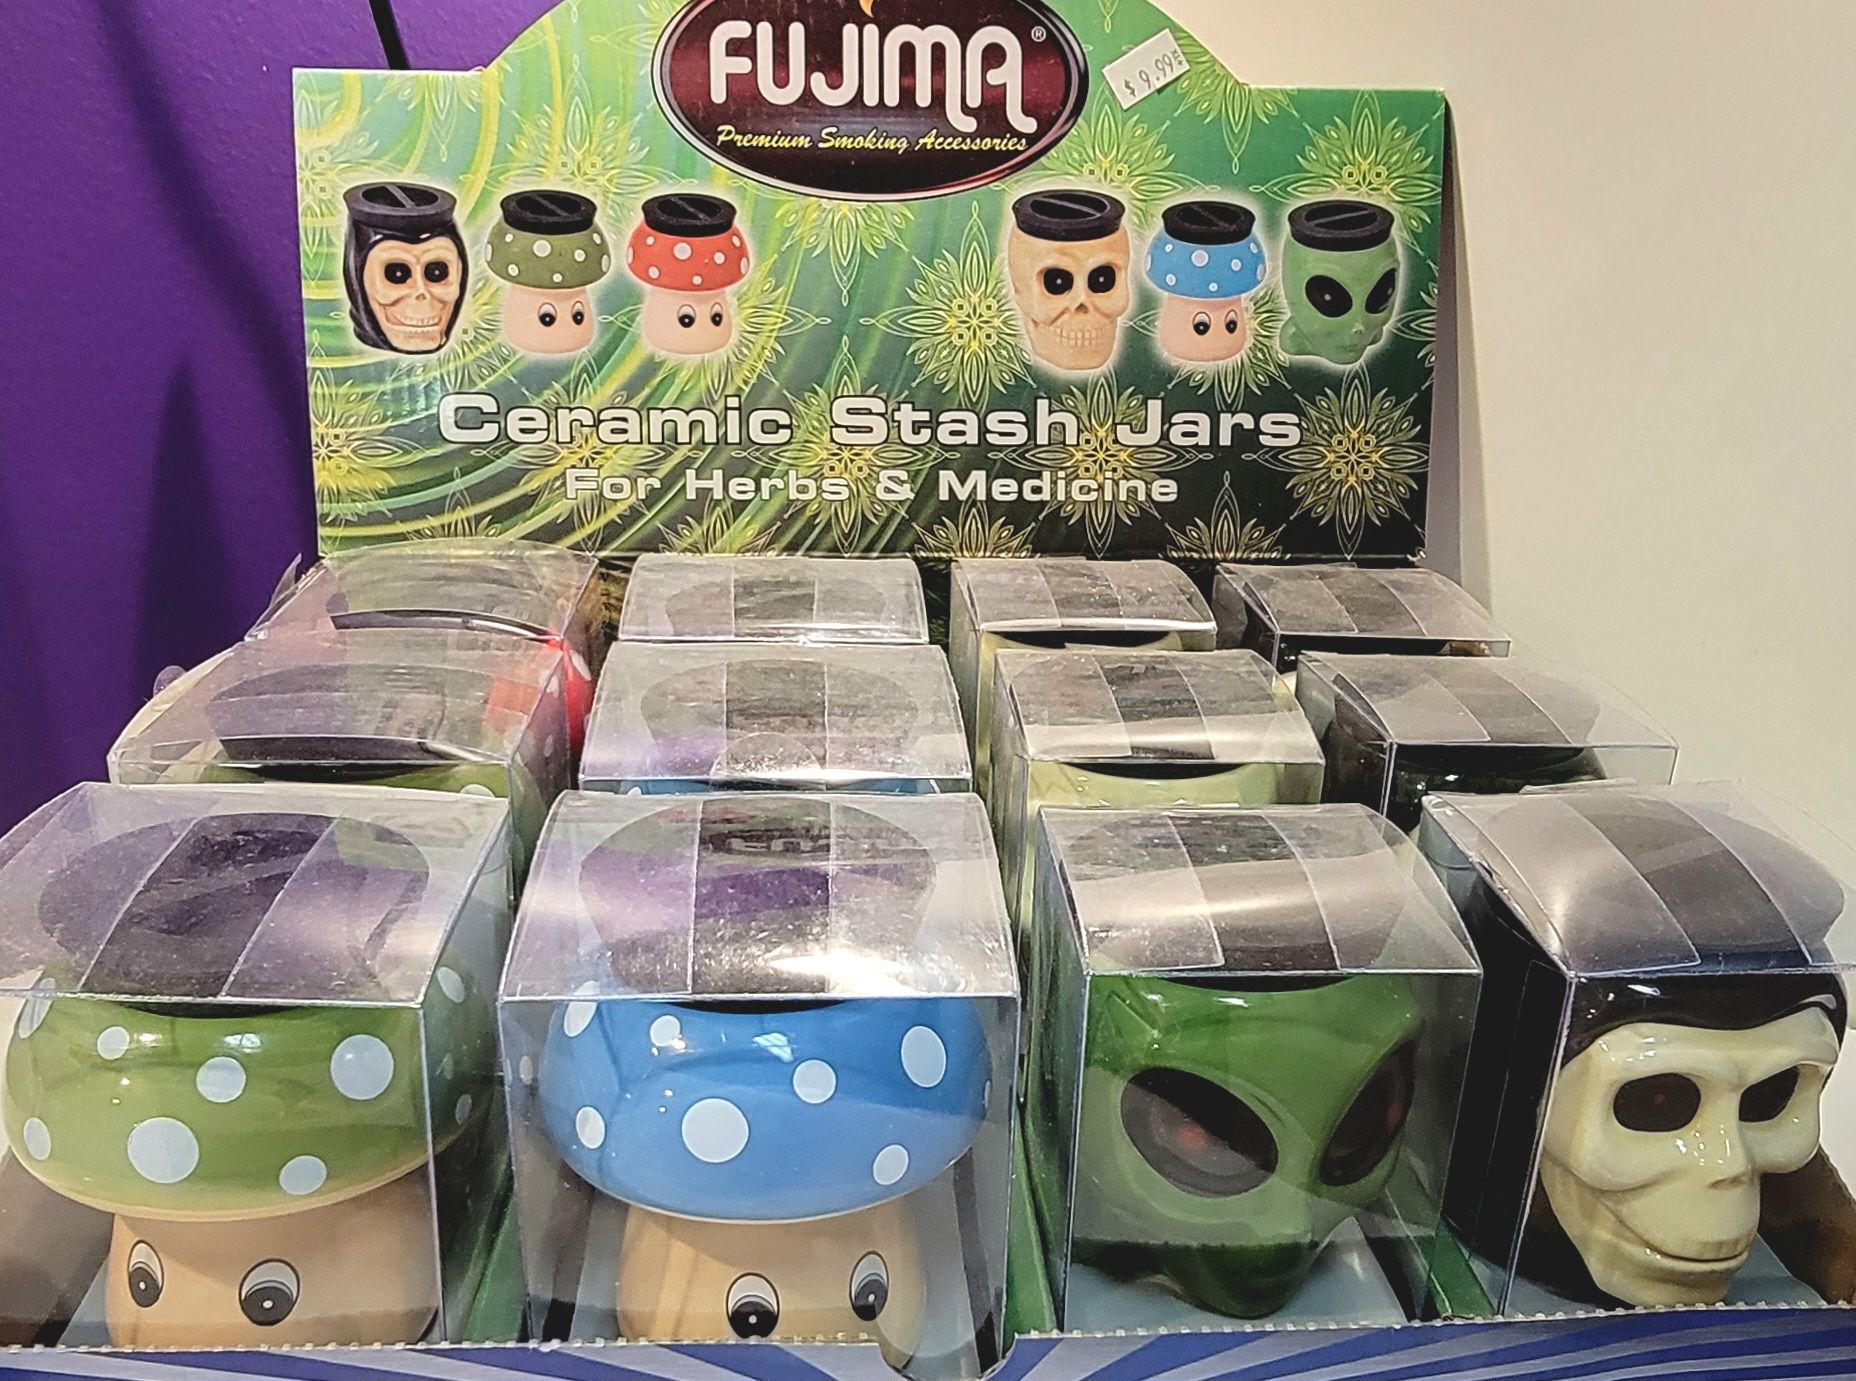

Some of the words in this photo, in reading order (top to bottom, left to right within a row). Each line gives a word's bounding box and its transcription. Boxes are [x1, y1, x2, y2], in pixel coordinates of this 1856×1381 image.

[708, 20, 1038, 133] FUJIMA
[716, 124, 812, 150] Premium
[818, 128, 908, 154] Smoking
[913, 131, 1029, 153] Accessories
[437, 393, 793, 447] Ceramic
[829, 395, 1079, 448] Stash
[1112, 397, 1303, 447] Jars
[564, 468, 661, 502] For
[685, 468, 850, 503] Herbs
[875, 469, 914, 502] &
[938, 469, 1180, 503] Medicine
